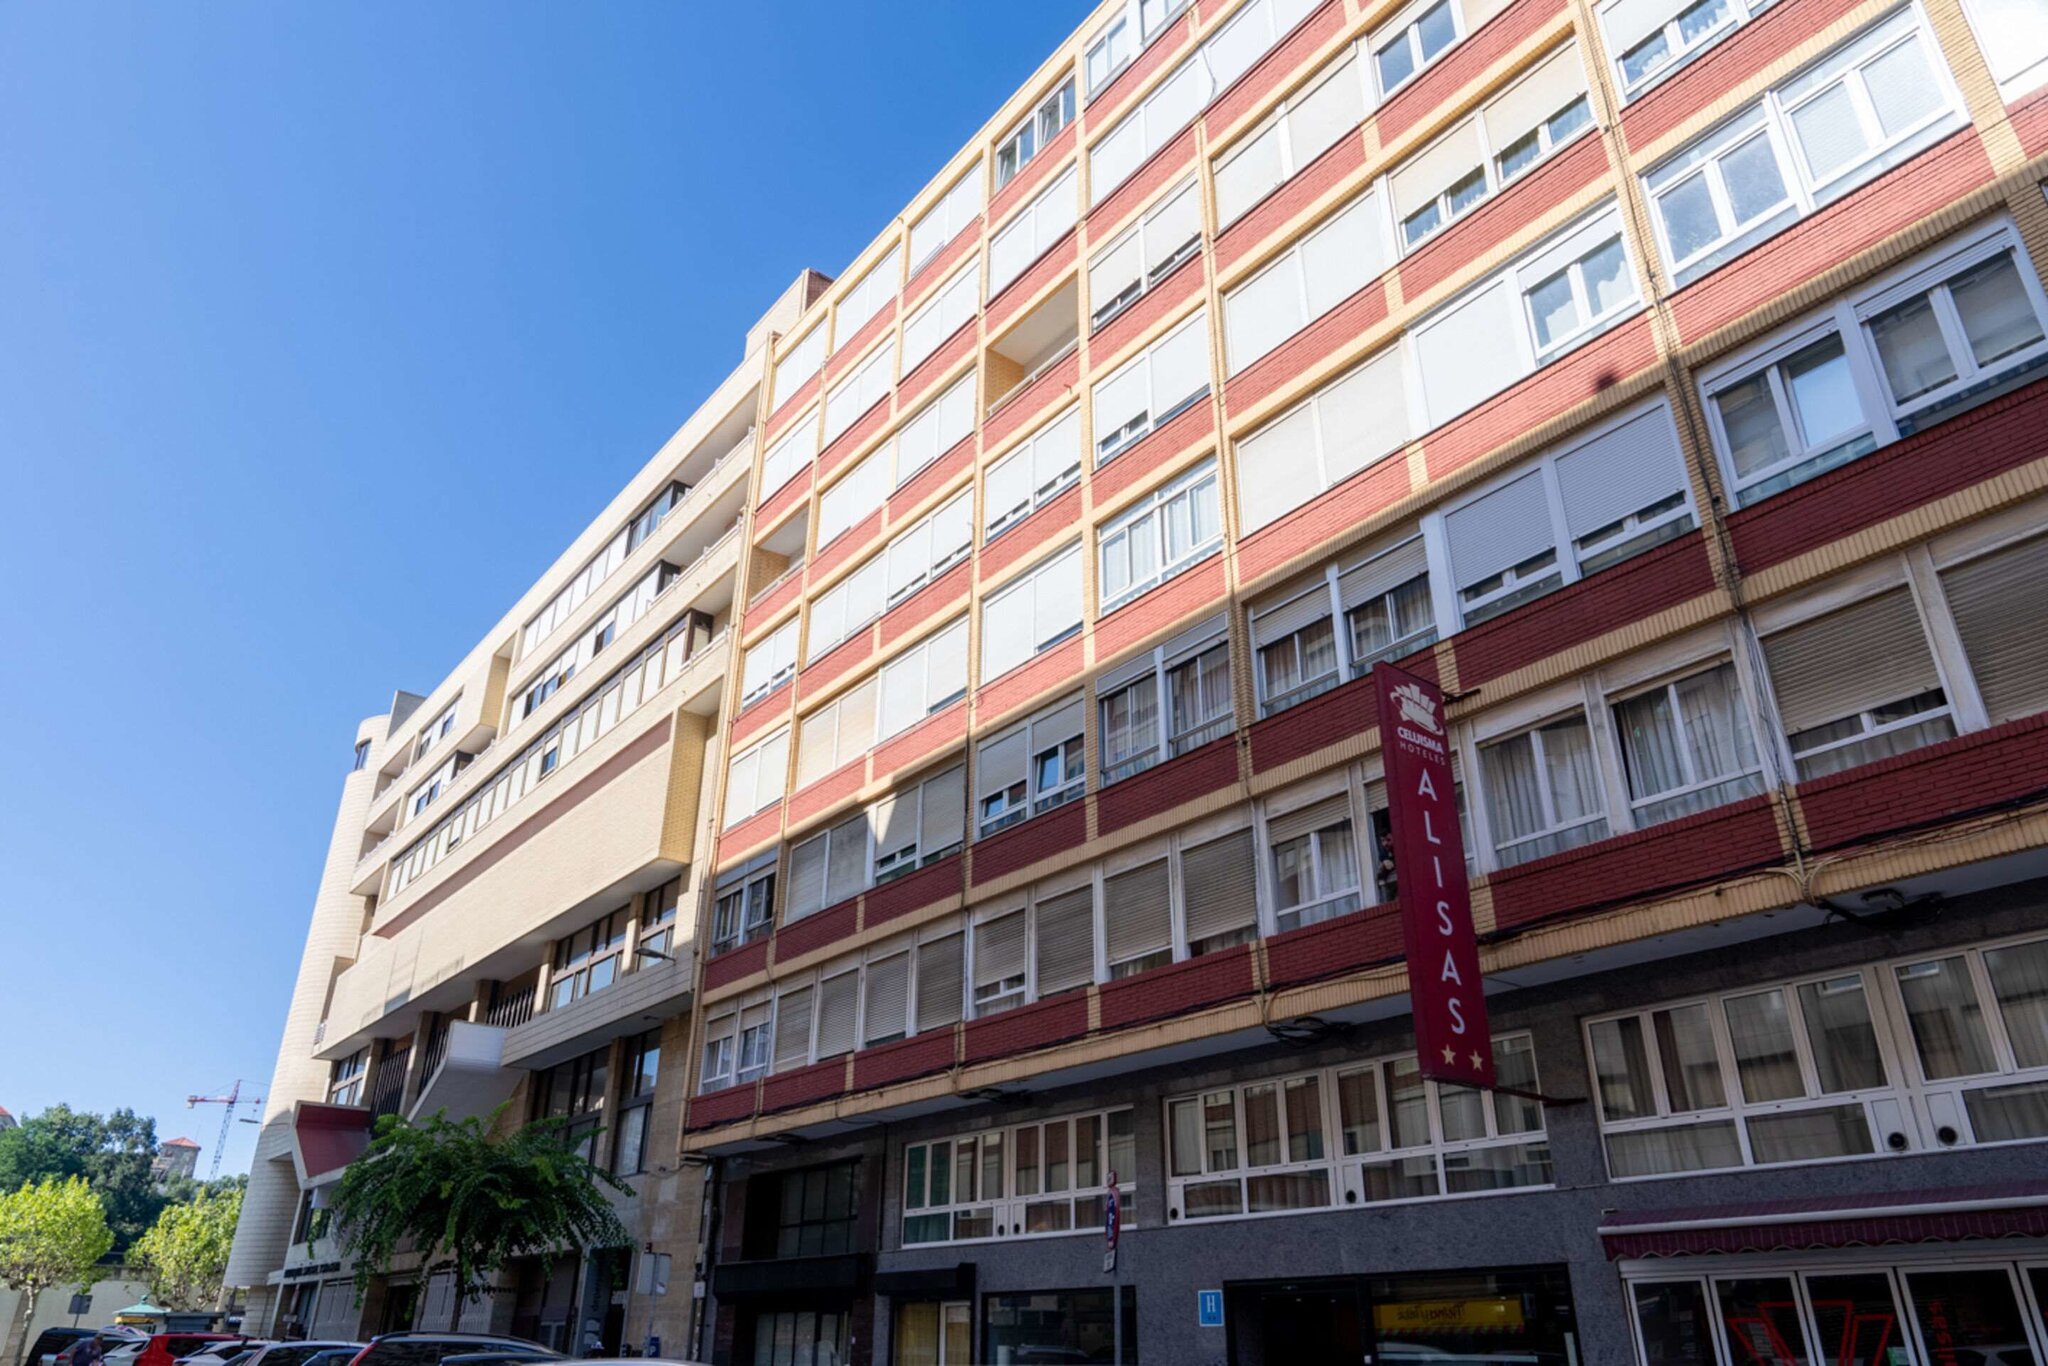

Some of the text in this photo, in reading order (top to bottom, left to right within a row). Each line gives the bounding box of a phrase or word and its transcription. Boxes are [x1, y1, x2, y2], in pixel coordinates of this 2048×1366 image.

[1400, 741, 1446, 766] HOTELES
[1417, 767, 1466, 1035] ALISAS
[1206, 1295, 1216, 1312] H
